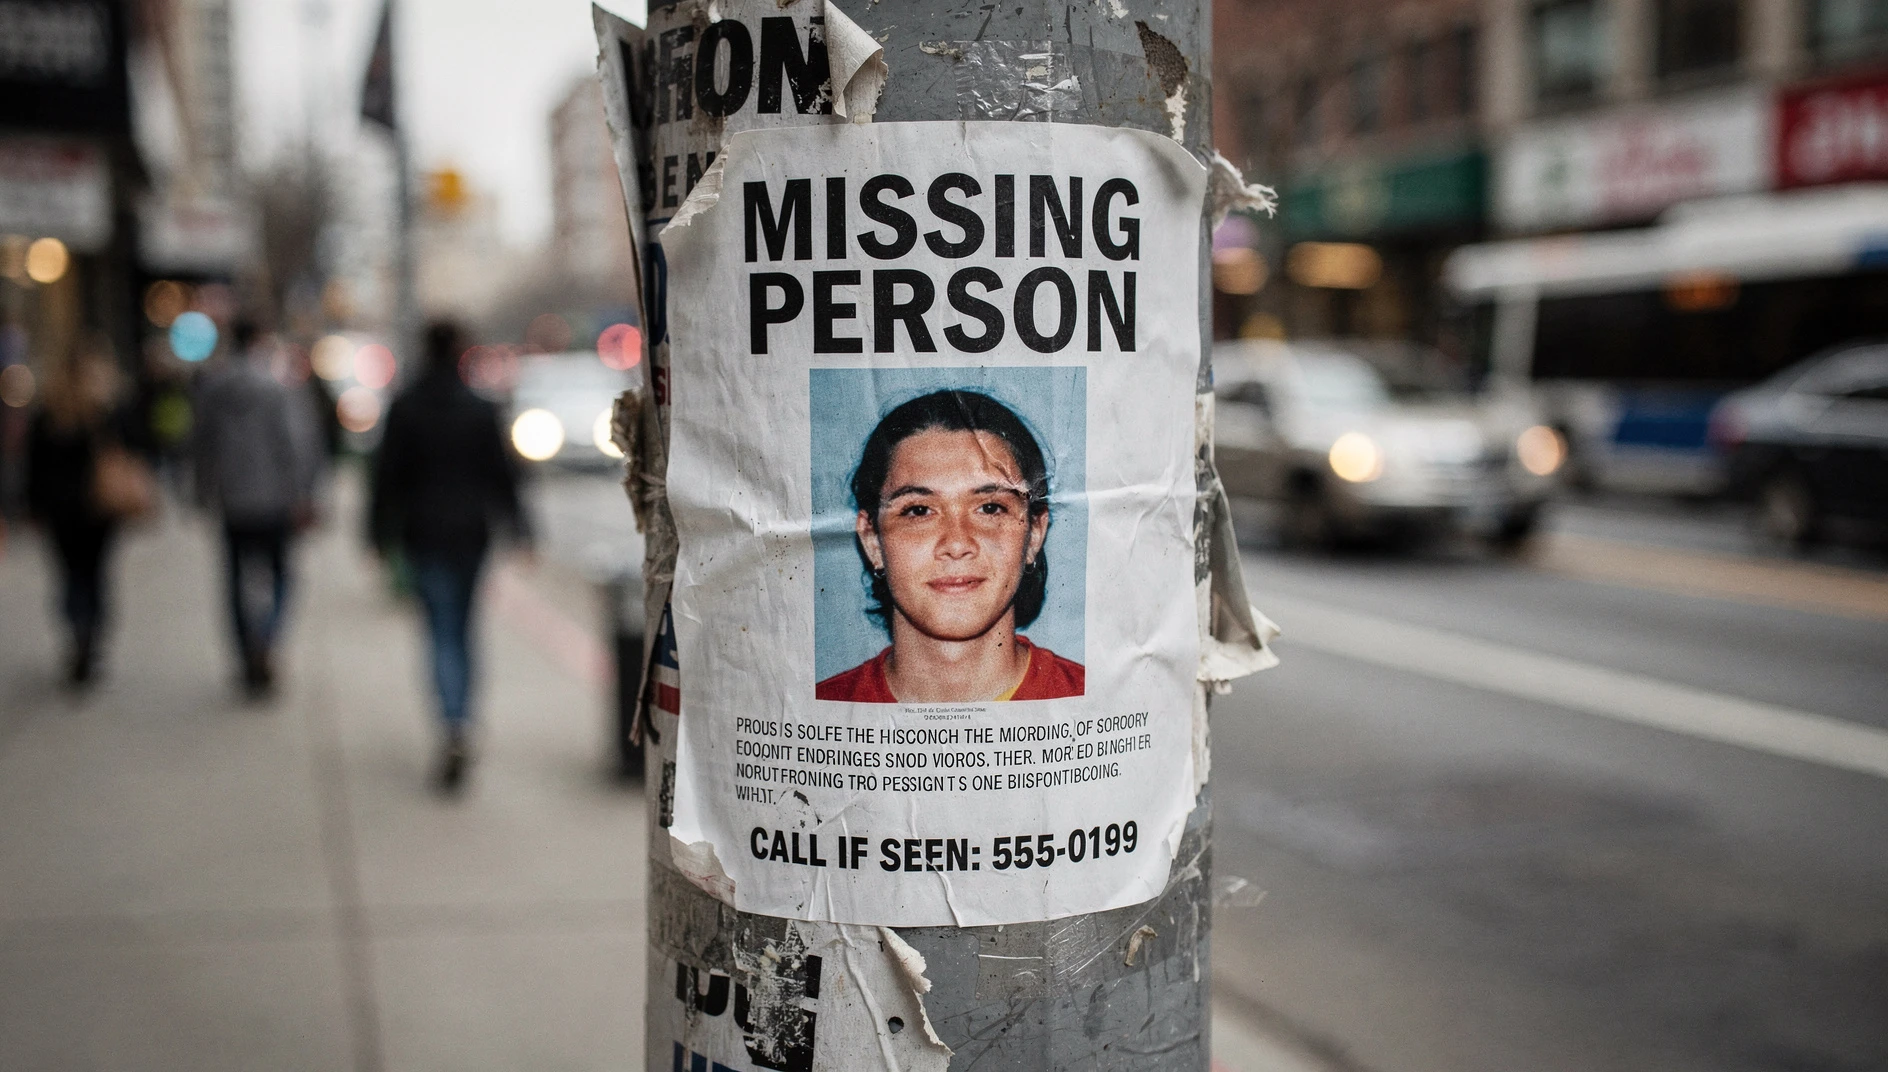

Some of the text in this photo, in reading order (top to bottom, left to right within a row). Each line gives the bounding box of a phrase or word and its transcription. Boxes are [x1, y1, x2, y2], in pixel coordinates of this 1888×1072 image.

[743, 172, 1141, 263] MISSING
[749, 266, 1137, 355] PERSON
[797, 724, 843, 742] SOLFE
[847, 727, 875, 744] THE
[880, 728, 959, 745] HISCONCH
[964, 728, 994, 744] THE
[1076, 720, 1094, 737] OF
[1097, 712, 1149, 734] SOROORY
[797, 746, 881, 768] ENDRINGES
[885, 752, 928, 768] SNOD
[994, 749, 1036, 767] THER.
[848, 774, 877, 791] TRO
[972, 774, 1003, 791] ONE
[750, 820, 1138, 872] CALL IF SEEN: 555-0199
